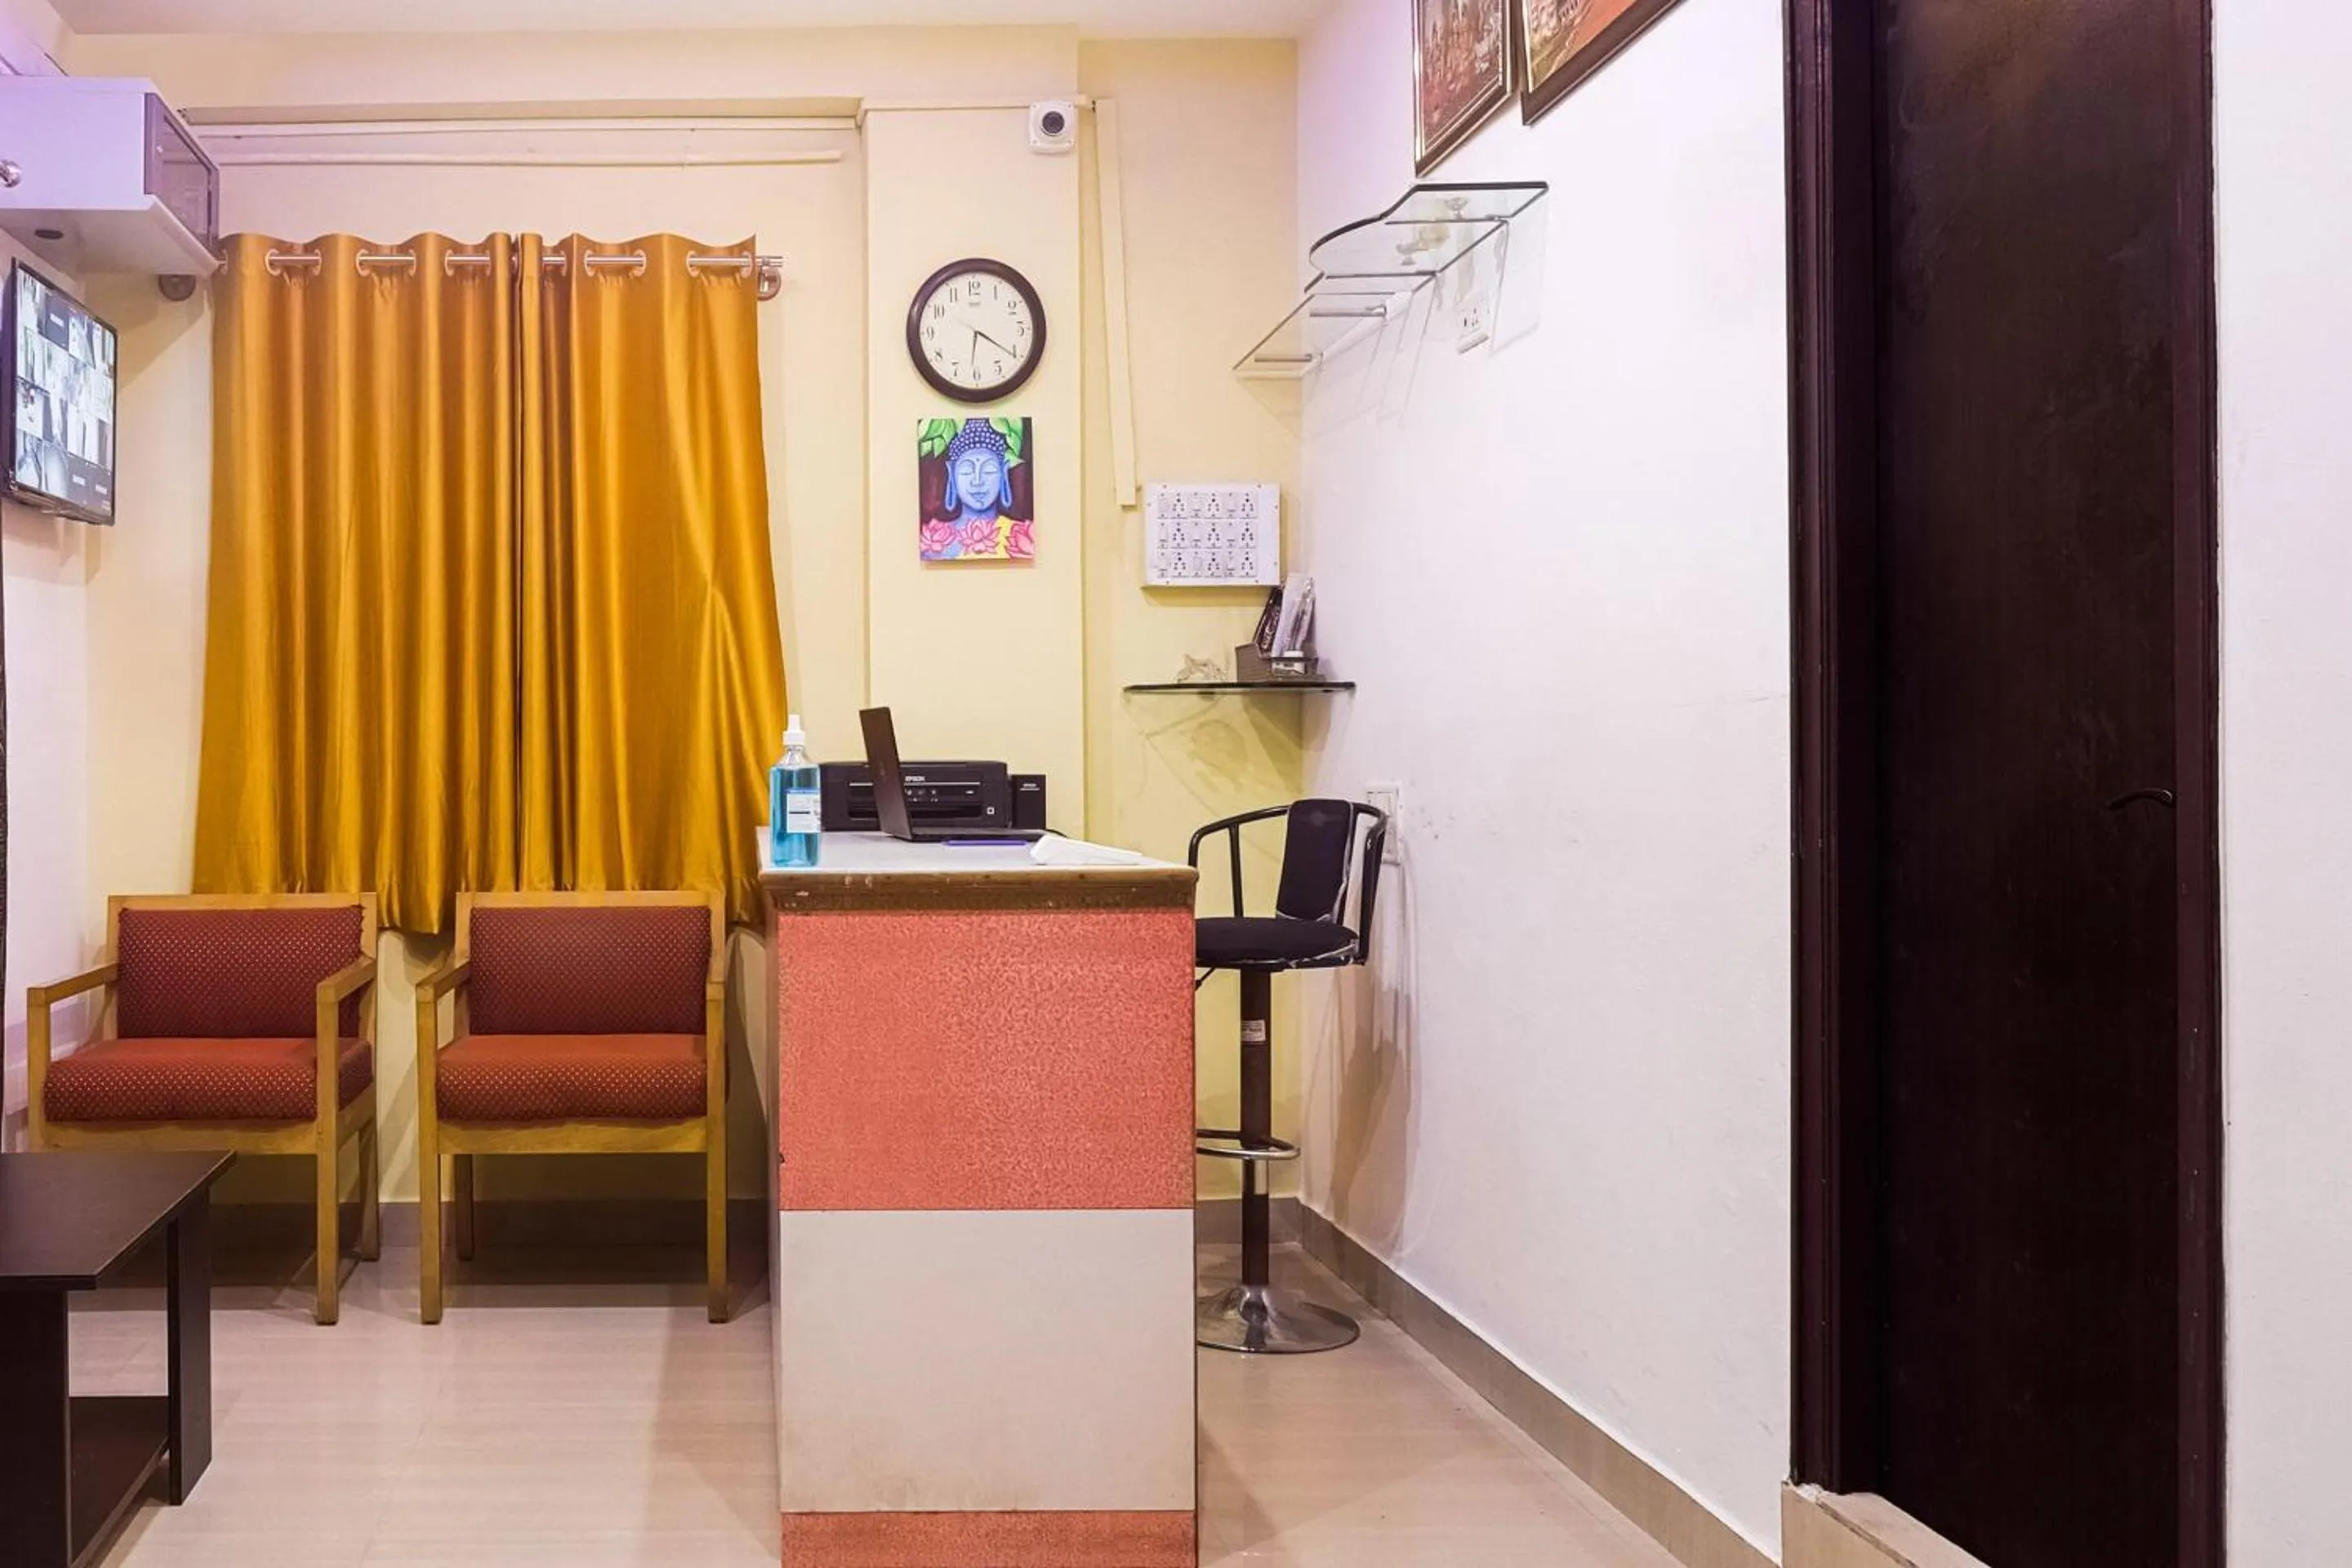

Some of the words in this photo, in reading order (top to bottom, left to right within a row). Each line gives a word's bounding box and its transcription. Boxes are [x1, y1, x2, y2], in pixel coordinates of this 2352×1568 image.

[949, 287, 958, 303] 11
[969, 280, 981, 296] 12
[933, 305, 945, 319] 10
[1007, 300, 1017, 315] 2
[926, 326, 934, 341] 9
[1017, 320, 1025, 336] 3
[951, 361, 960, 376] 7
[973, 365, 981, 381] 6
[994, 359, 1002, 375] 5
